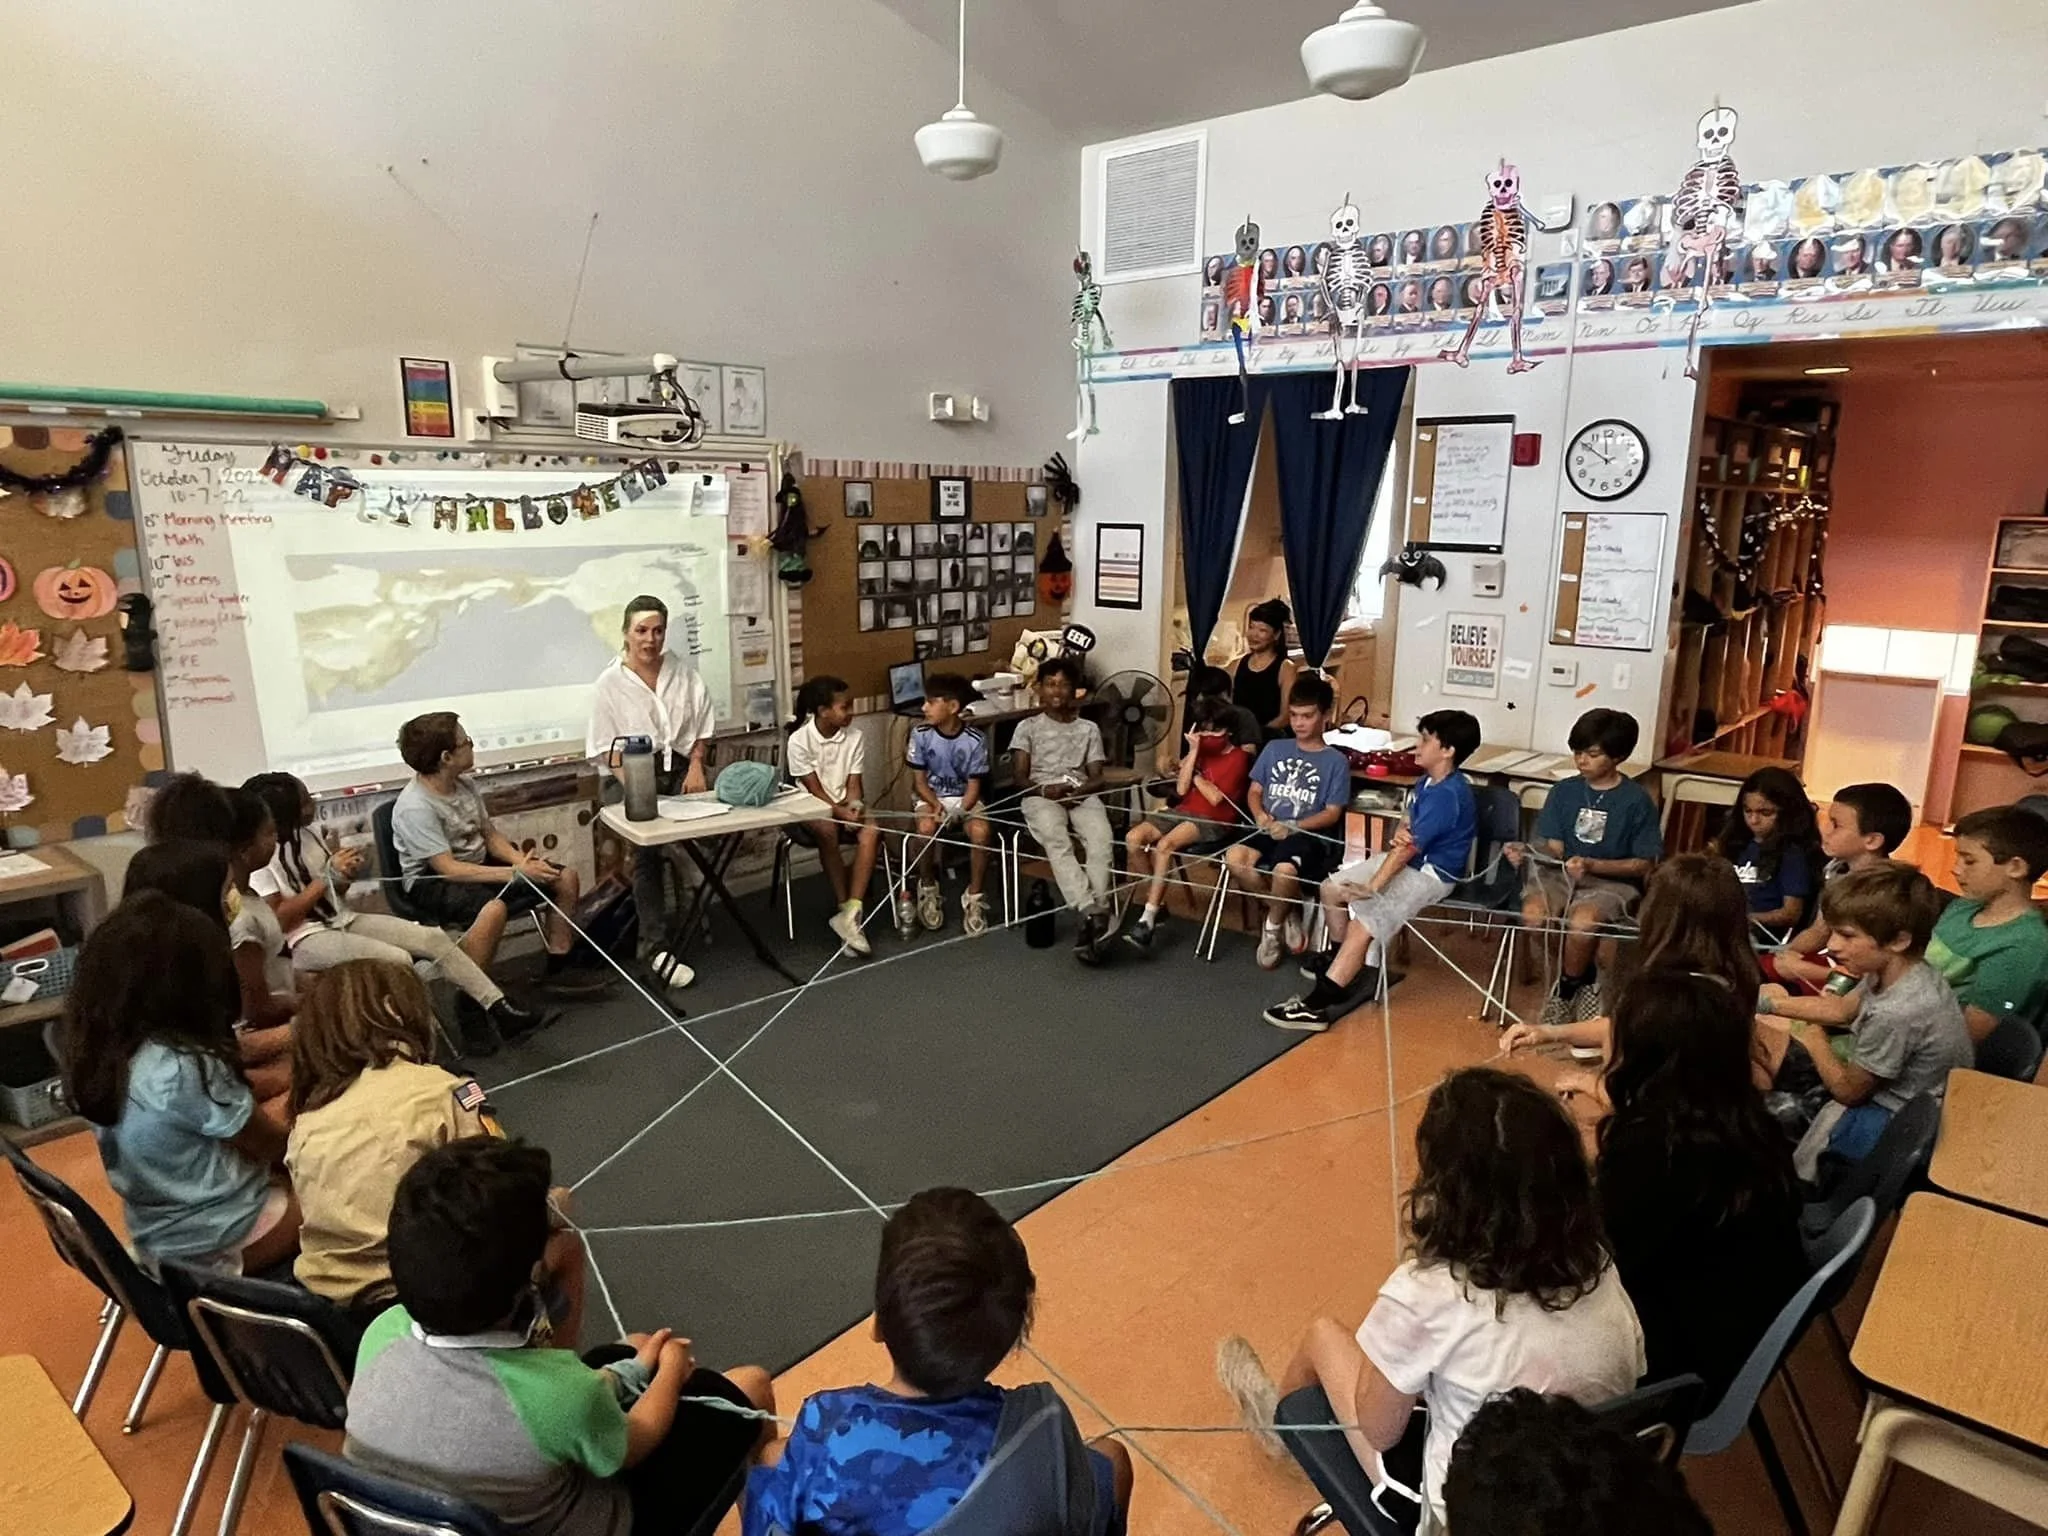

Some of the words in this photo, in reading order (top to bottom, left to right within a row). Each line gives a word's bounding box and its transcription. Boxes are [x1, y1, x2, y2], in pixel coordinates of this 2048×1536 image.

[1603, 429, 1615, 438] 12
[162, 444, 237, 468] Friday
[1576, 456, 1584, 465] 9
[140, 468, 199, 487] October
[1578, 469, 1587, 478] 8
[1624, 469, 1633, 477] 4
[1589, 478, 1596, 487] 7
[1600, 482, 1608, 491] 6
[1614, 478, 1622, 487] 5
[171, 487, 249, 505] 10-7-22
[164, 533, 205, 546] Math
[1066, 629, 1092, 648] EEK!
[1450, 624, 1488, 646] BELIEVE
[180, 654, 200, 667] PE
[1450, 645, 1497, 669] YOURSELF
